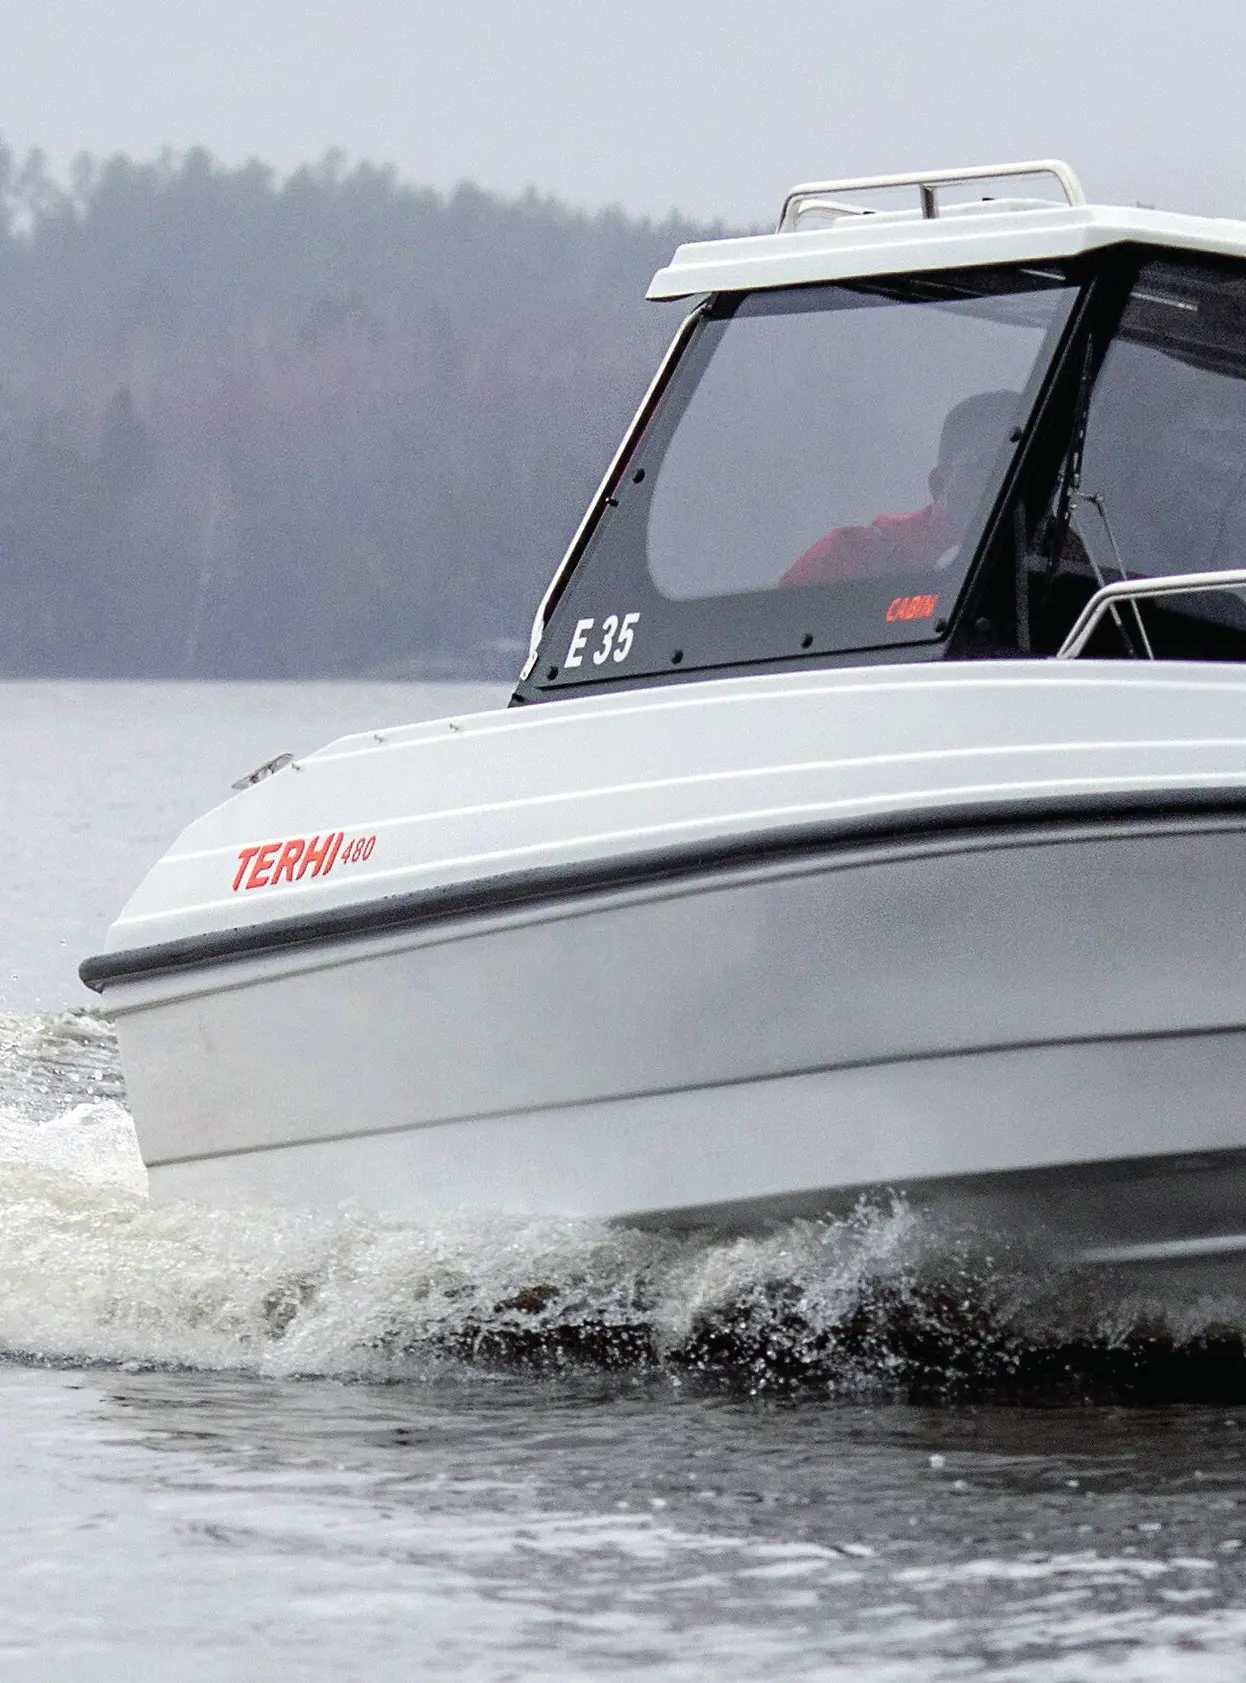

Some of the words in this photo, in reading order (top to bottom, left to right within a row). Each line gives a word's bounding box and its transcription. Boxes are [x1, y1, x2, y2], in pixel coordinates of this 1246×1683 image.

[564, 618, 594, 668] E
[593, 612, 641, 665] 35
[232, 832, 344, 892] TERHI
[341, 836, 377, 865] 480
